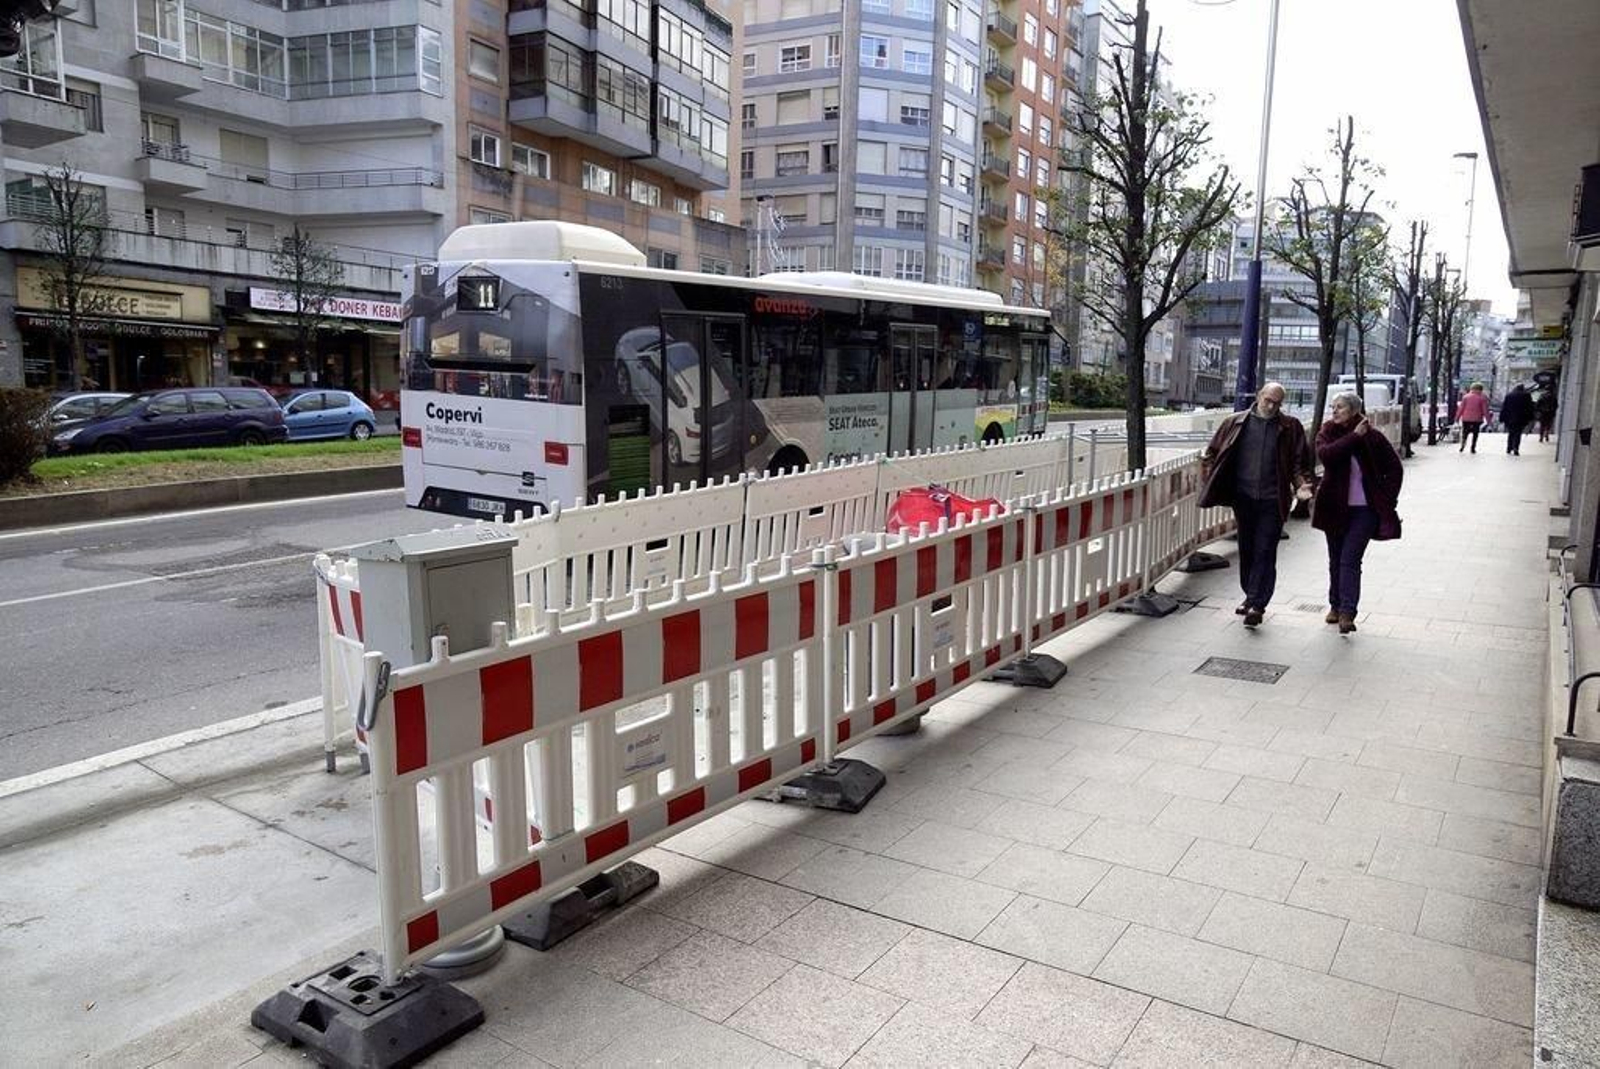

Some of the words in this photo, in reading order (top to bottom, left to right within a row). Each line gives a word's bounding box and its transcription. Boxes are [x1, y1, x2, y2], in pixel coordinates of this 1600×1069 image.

[600, 275, 624, 290] 6213
[478, 283, 495, 309] 11
[329, 299, 367, 316] DONER
[372, 302, 402, 319] KEBA
[425, 402, 483, 424] Copervi
[828, 416, 851, 432] SEAT
